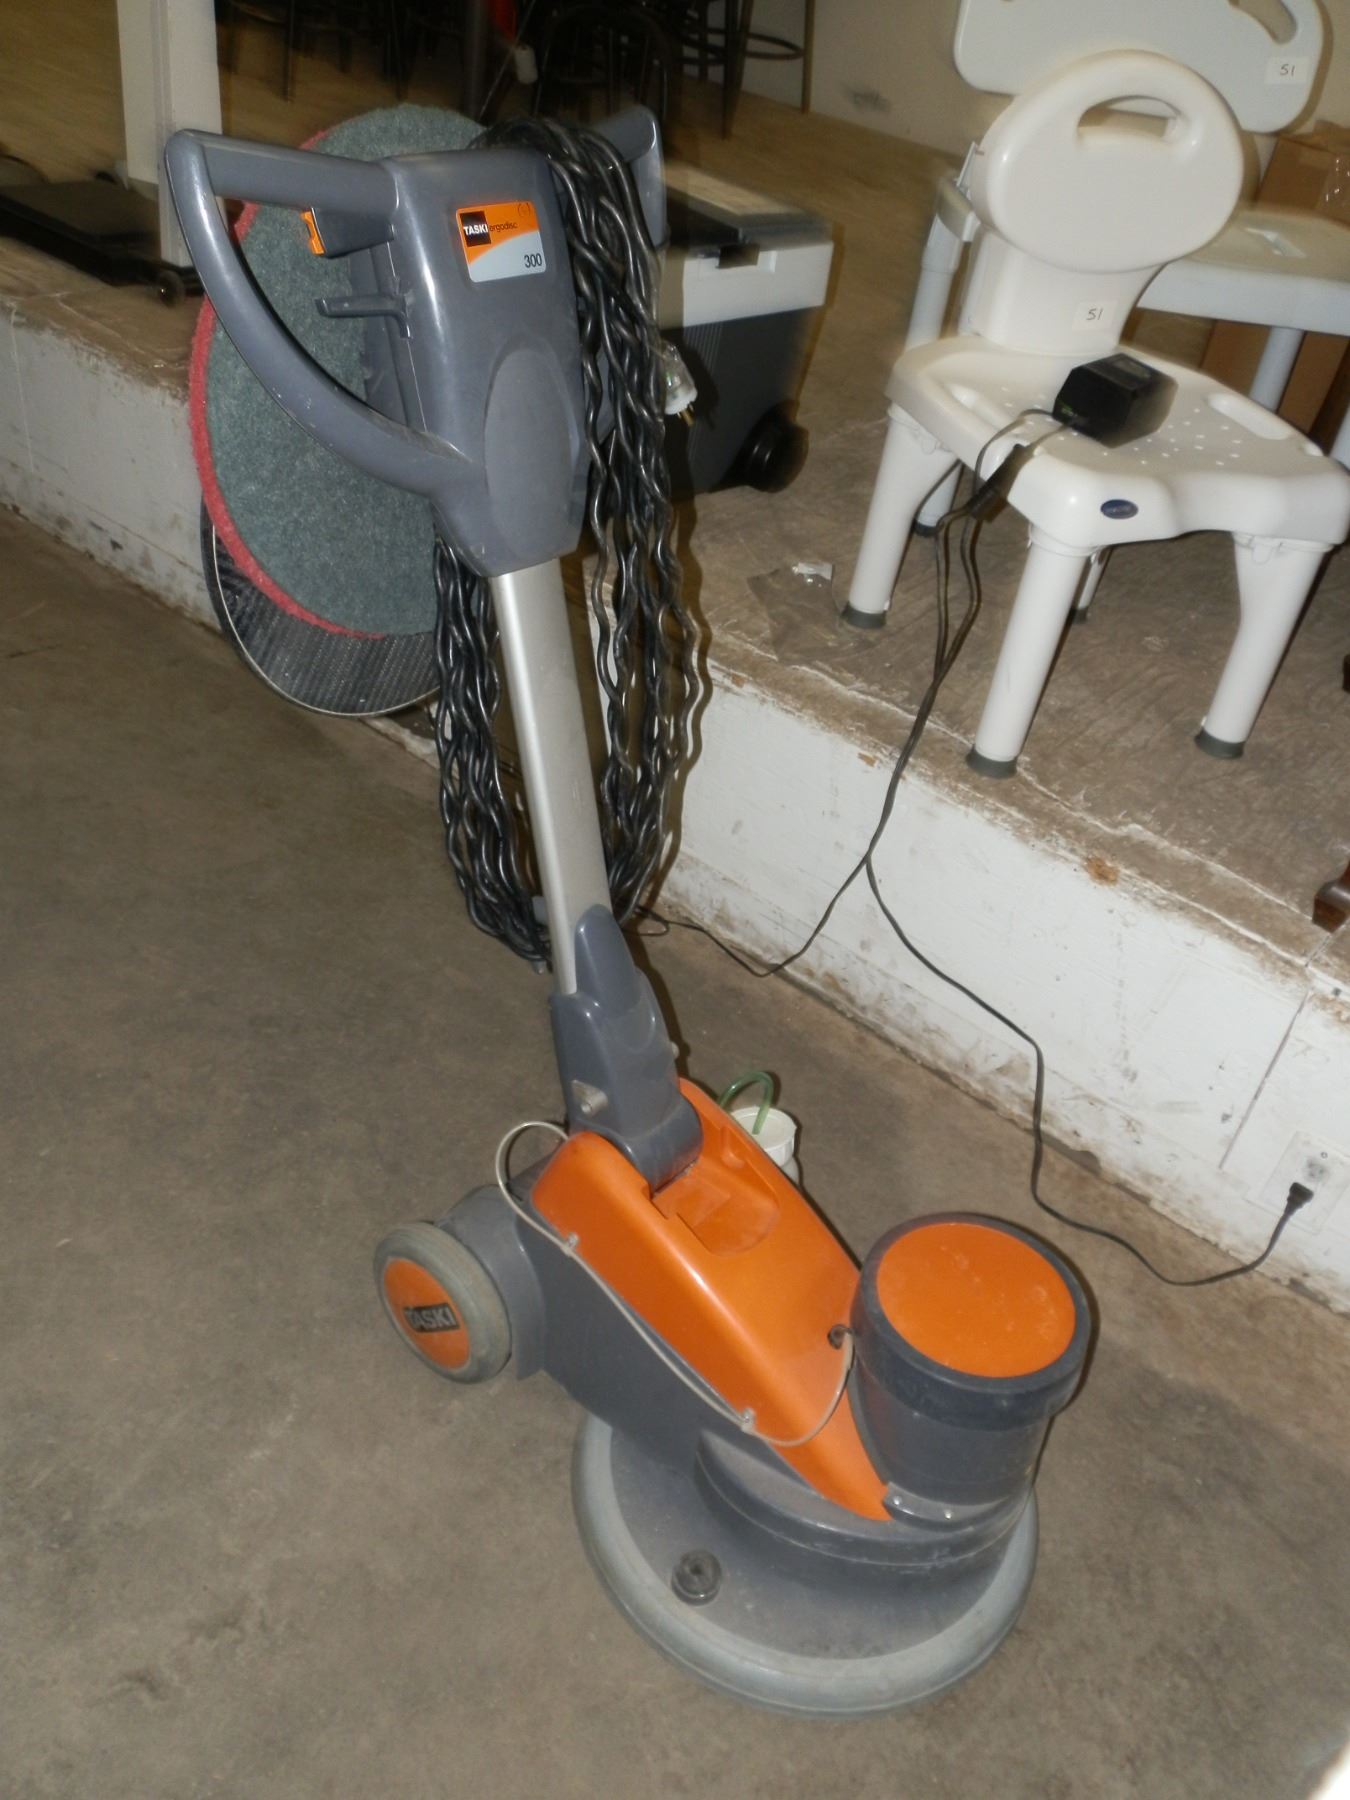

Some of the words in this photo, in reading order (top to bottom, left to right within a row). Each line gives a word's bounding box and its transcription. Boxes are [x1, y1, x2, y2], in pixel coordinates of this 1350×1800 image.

[463, 223, 488, 235] TASKI
[489, 222, 518, 233] ergodisc
[524, 253, 543, 268] 300
[405, 1305, 458, 1330] TASKI
